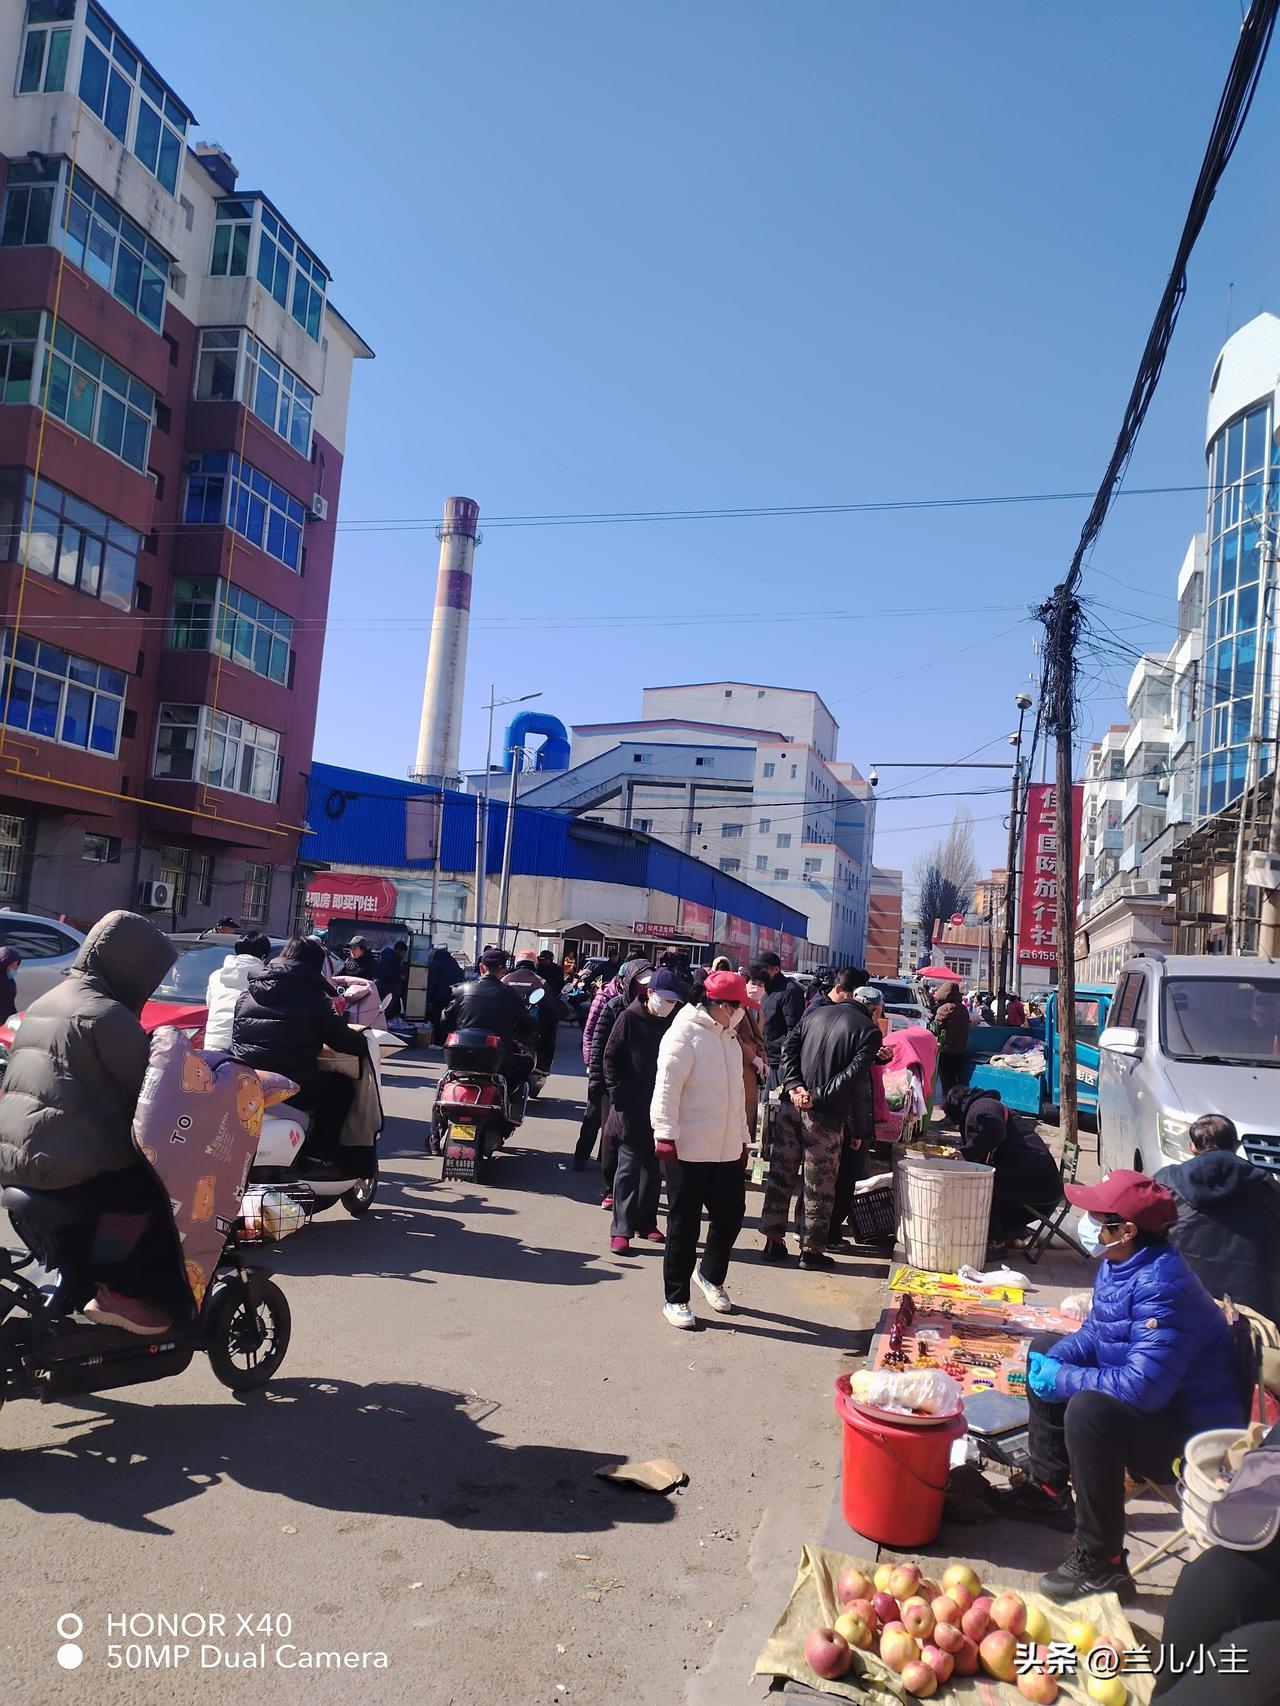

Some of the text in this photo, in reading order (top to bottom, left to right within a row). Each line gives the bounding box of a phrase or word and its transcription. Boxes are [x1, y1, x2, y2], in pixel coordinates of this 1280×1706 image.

[333, 894, 379, 912] 即买即住!
[1031, 949, 1058, 961] 6155
[170, 1115, 193, 1143] TO
